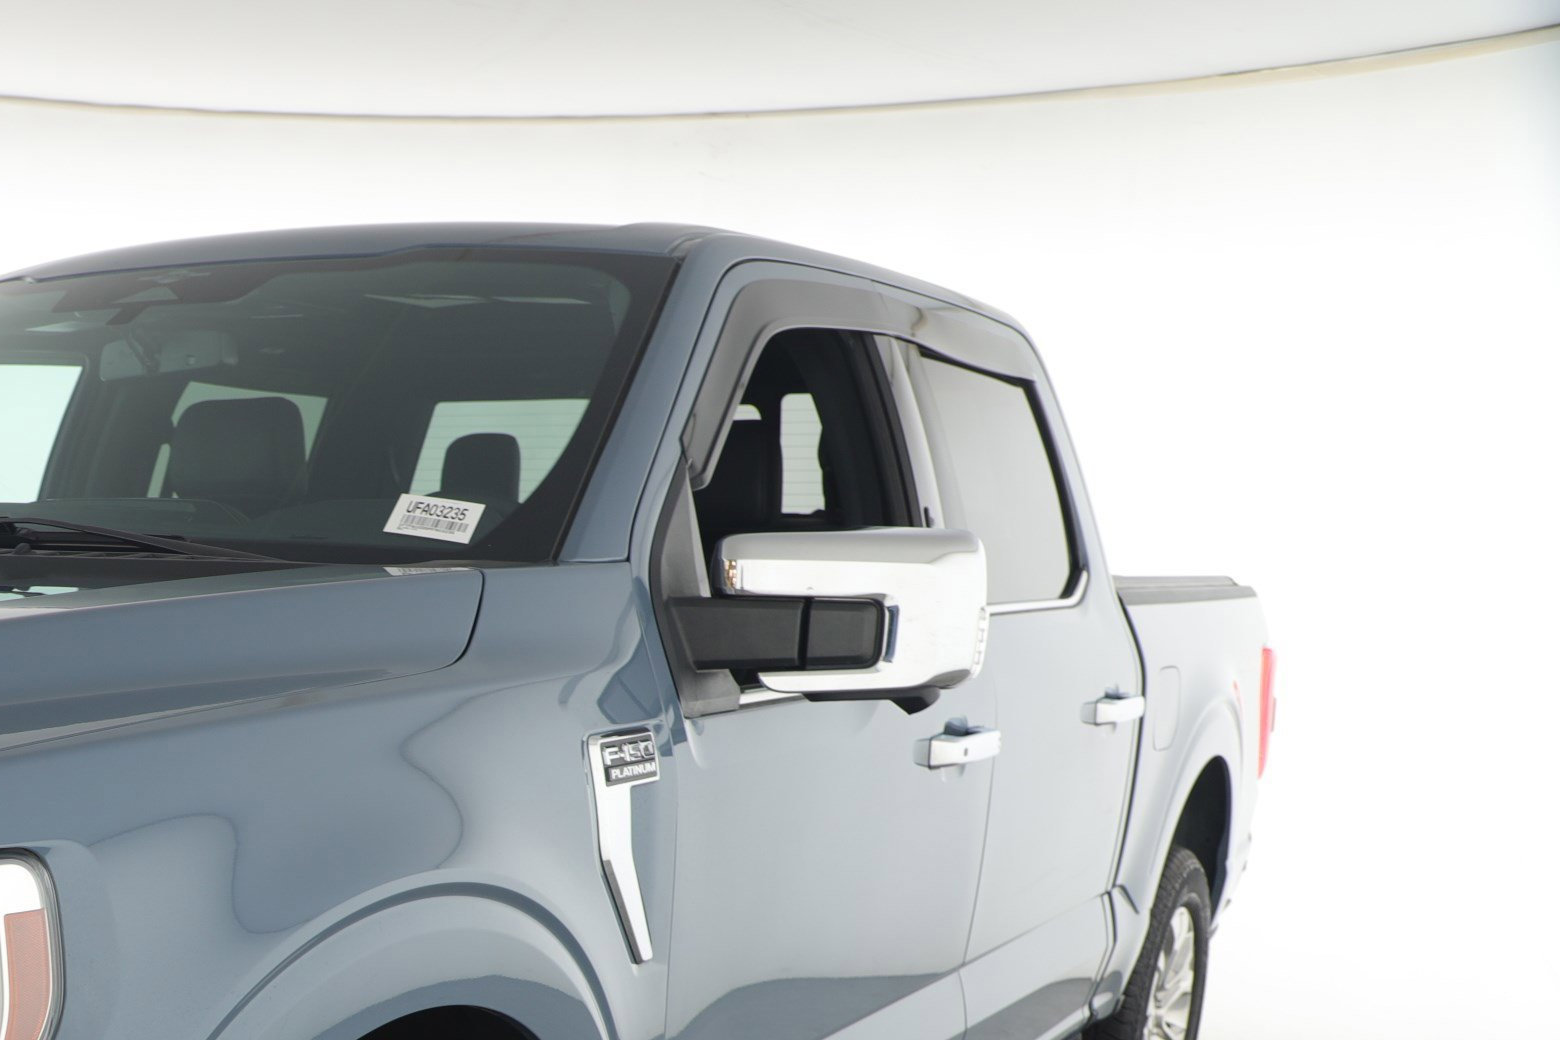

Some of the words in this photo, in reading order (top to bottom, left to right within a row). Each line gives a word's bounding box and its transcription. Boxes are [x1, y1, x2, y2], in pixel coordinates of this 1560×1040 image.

[406, 500, 469, 521] UFA03235
[603, 740, 655, 765] F-150
[611, 761, 657, 780] PLATINUM
